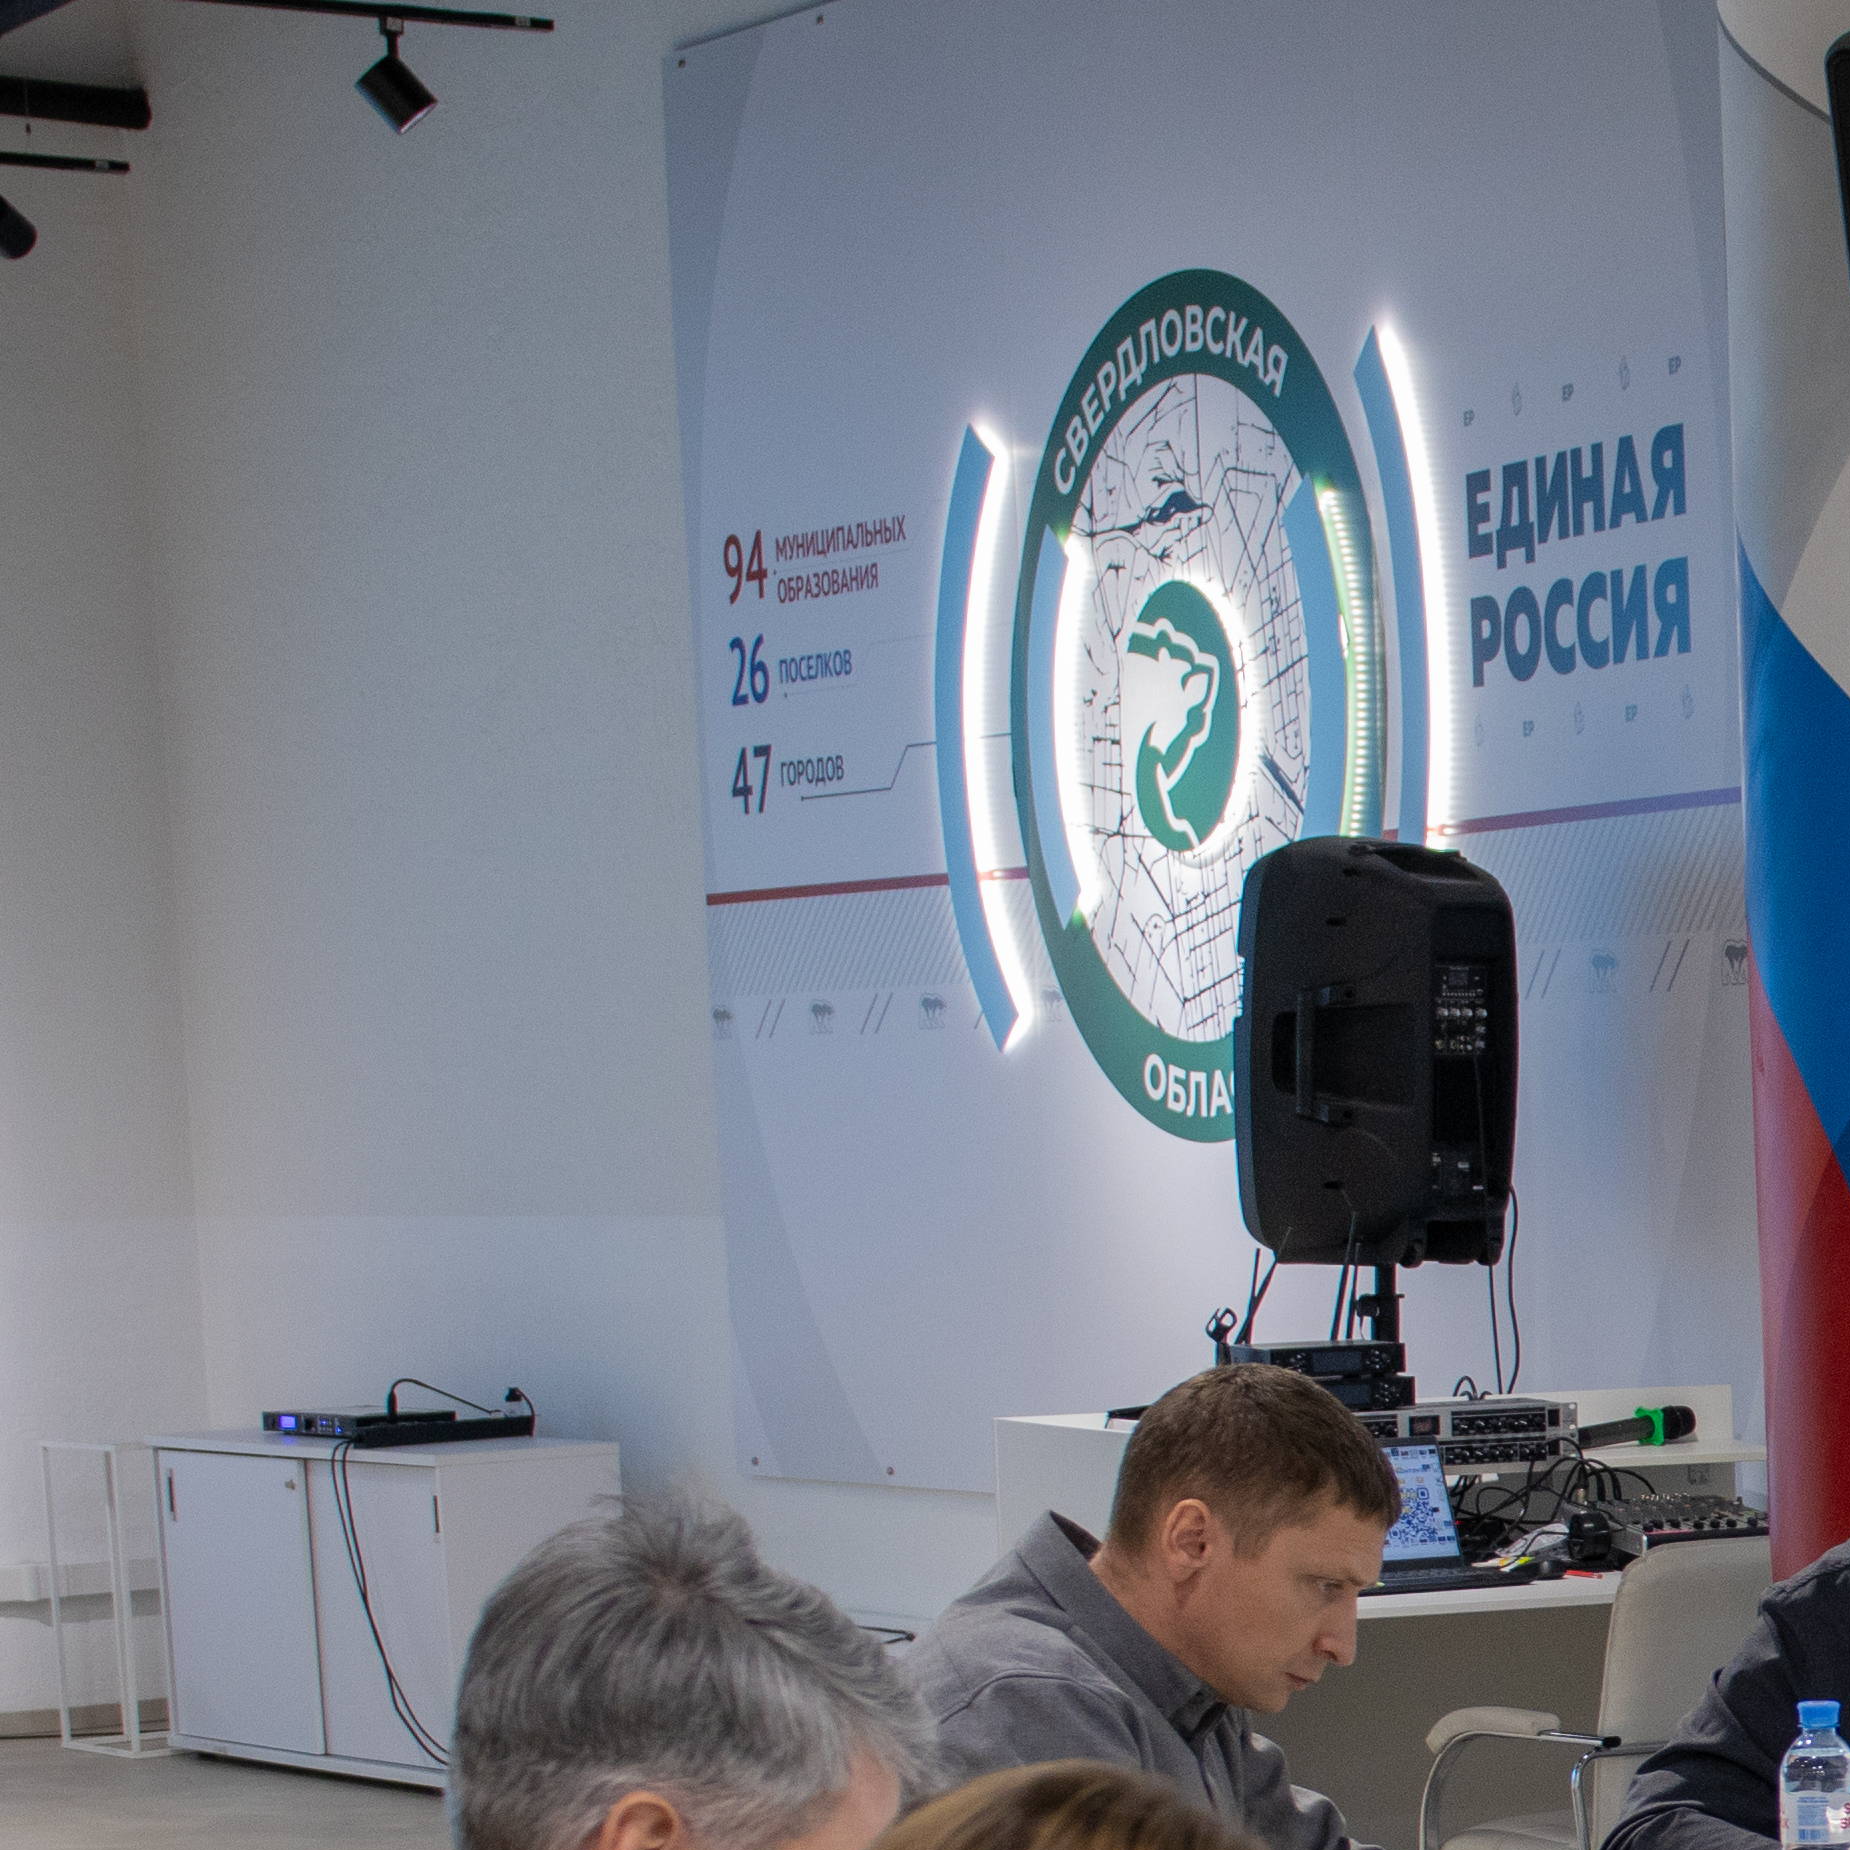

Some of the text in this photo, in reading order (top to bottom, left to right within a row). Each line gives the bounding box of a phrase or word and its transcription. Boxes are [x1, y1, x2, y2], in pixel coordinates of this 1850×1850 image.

[1053, 303, 1289, 496] СВЕРДЛОВСКАЯ
[1465, 423, 1687, 570] ЕДИНАЯ
[724, 530, 768, 605] 94
[775, 515, 907, 562] МУНИЦИПАЛЬНЫХ
[777, 563, 880, 604] ОБРАЗОВАНИЯ
[1470, 555, 1692, 688] РОССИЯ
[729, 633, 770, 706] 26
[779, 649, 853, 684] ПОСЕЛКОВ
[731, 744, 772, 814] 47
[780, 755, 845, 788] ГОРОДОВ
[1144, 1053, 1235, 1119] ОБЛА
